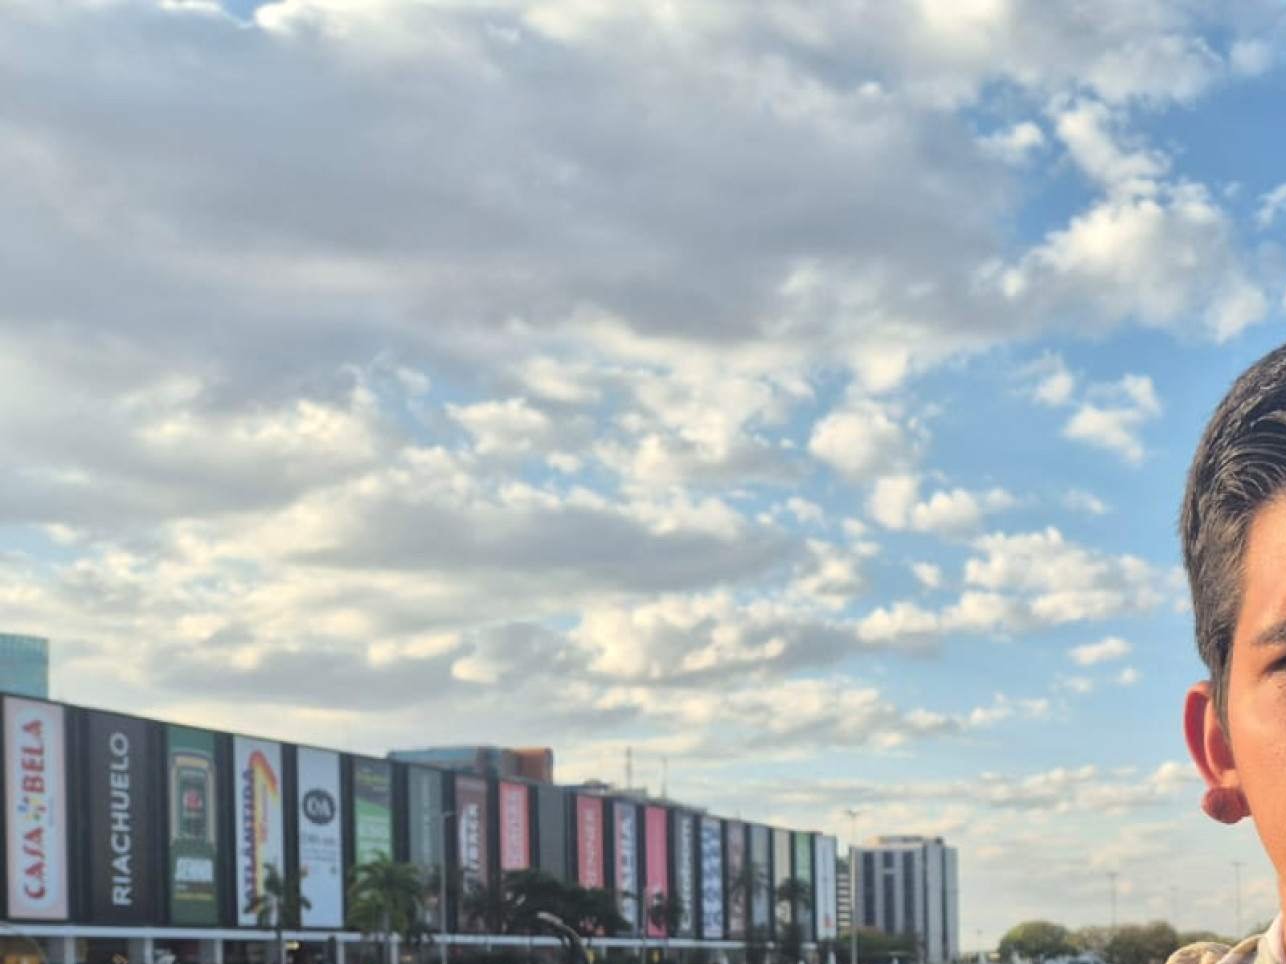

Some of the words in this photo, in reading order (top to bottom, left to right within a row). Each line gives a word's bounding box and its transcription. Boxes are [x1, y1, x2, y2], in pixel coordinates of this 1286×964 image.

[21, 719, 45, 794] BELA
[110, 731, 132, 906] RIACHUELO
[24, 826, 46, 899] CASA
